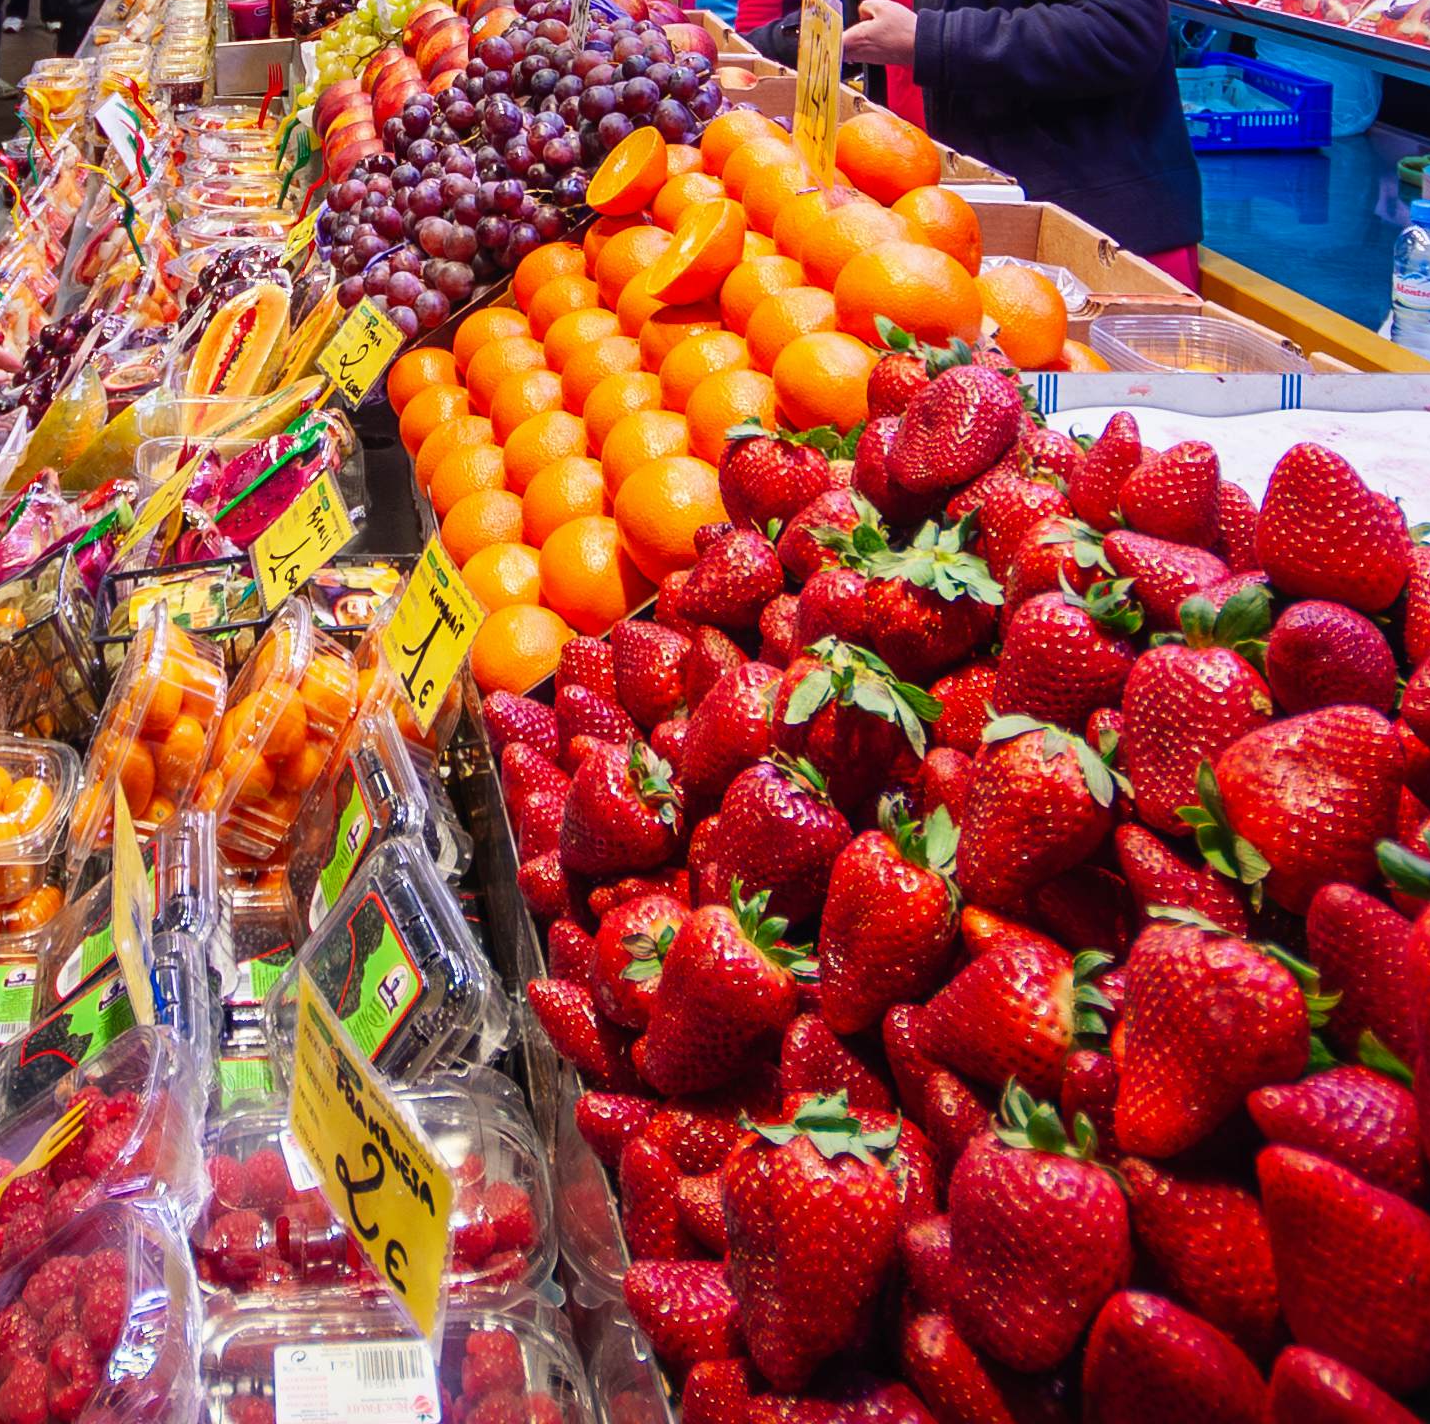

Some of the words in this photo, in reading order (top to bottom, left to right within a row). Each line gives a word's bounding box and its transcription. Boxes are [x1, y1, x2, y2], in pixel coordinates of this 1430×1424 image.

[339, 343, 370, 381] 2
[268, 536, 311, 584] 1
[400, 615, 443, 704] 1
[418, 679, 435, 710] €
[335, 1141, 385, 1242] 2
[384, 1238, 409, 1295] €
